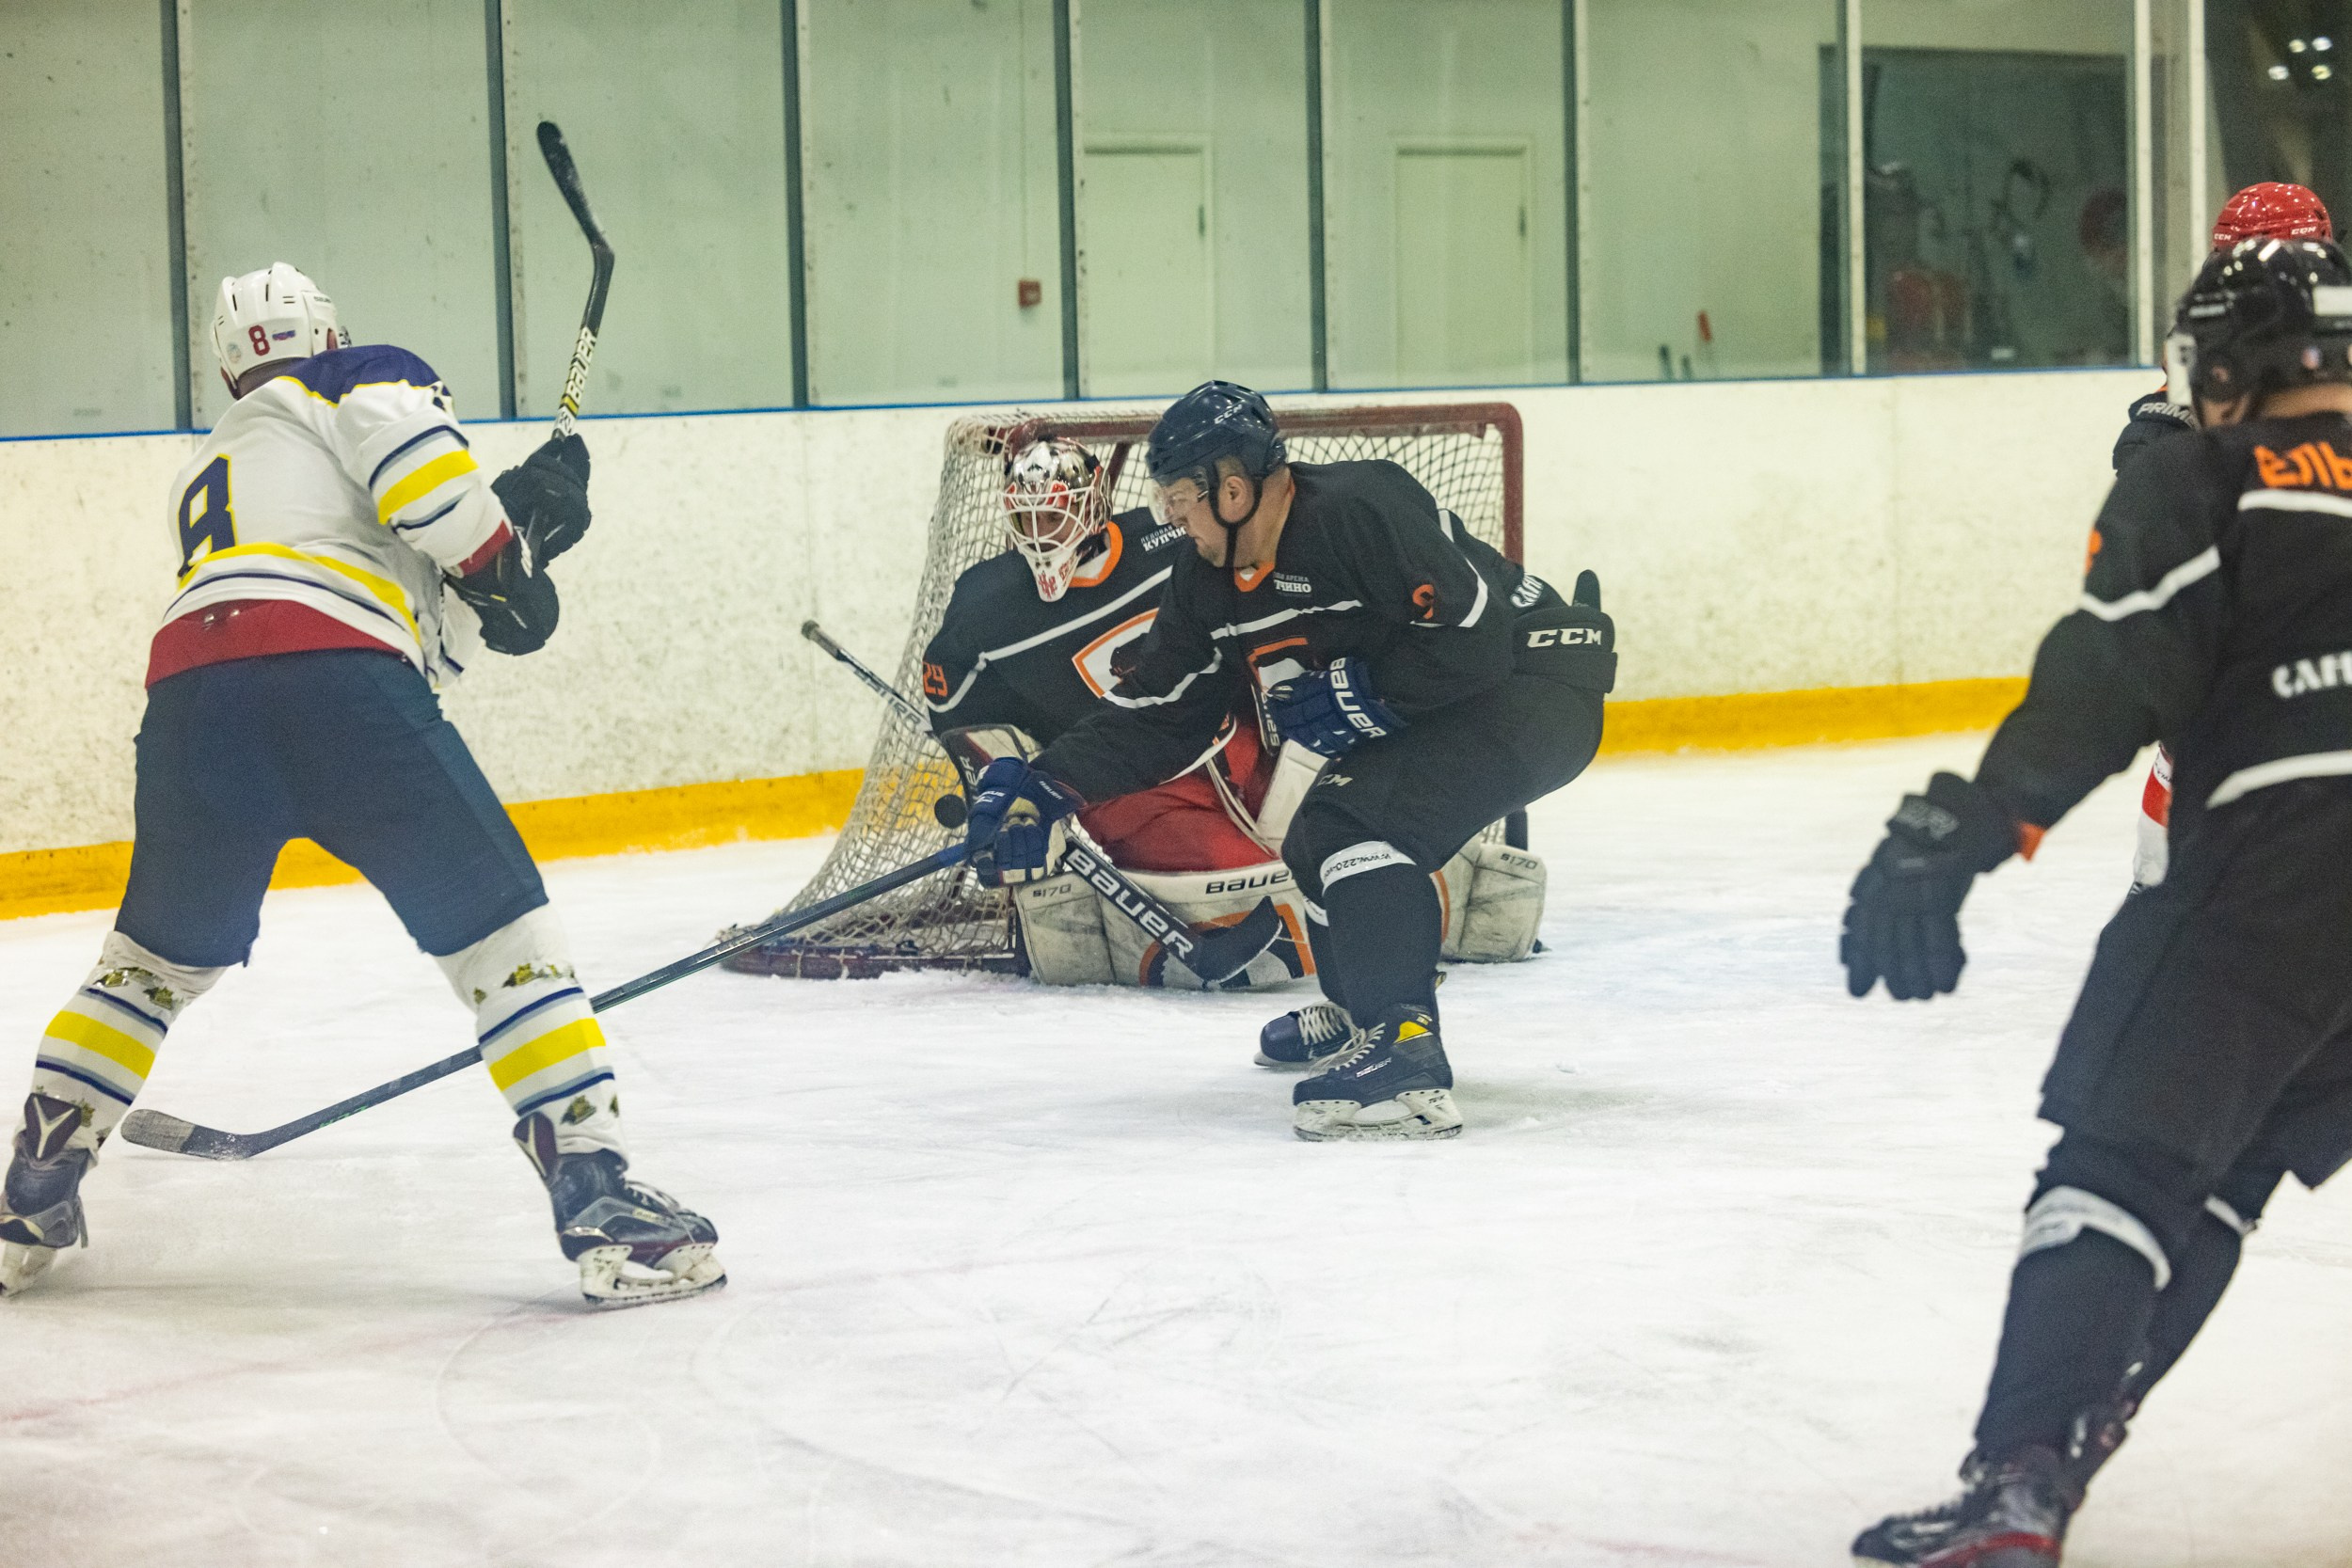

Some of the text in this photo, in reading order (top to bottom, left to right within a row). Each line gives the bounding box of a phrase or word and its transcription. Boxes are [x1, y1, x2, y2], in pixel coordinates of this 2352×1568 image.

[2291, 226, 2317, 235] CCM
[248, 325, 270, 356] 8
[565, 326, 597, 406] BAUER
[1214, 404, 1242, 424] CCM
[1143, 526, 1187, 552] КУПЧИ
[1510, 574, 1543, 608] САН
[1526, 627, 1602, 648] CCM
[1329, 657, 1388, 738] BAUER
[1317, 773, 1354, 786] CM
[1205, 868, 1290, 895] BAUE
[1065, 847, 1194, 959] BAUER
